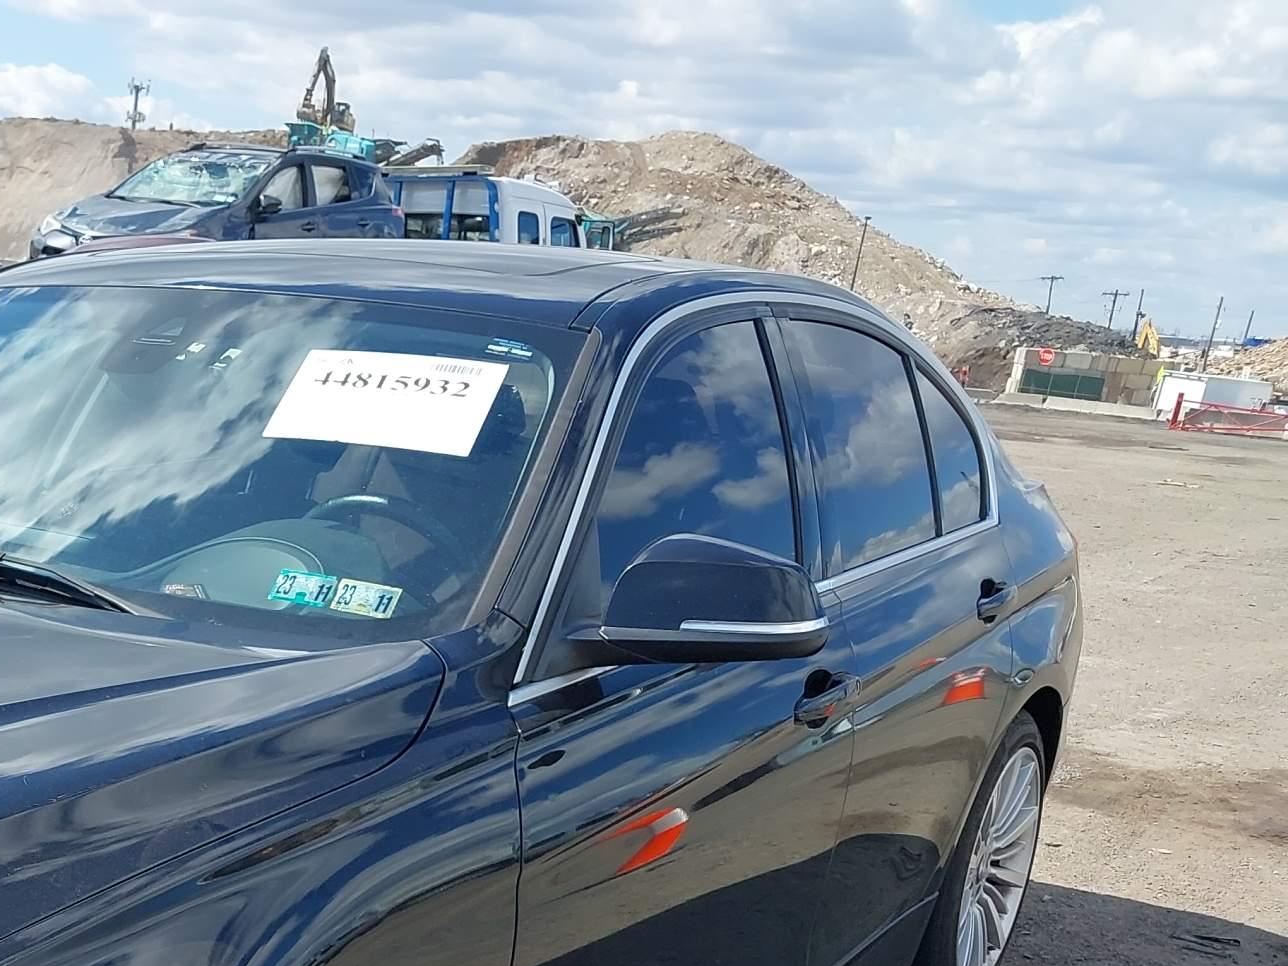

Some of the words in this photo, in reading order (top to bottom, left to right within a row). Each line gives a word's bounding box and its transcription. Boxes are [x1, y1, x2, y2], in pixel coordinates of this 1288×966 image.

[315, 370, 470, 398] 44815932
[276, 574, 297, 595] 23
[337, 583, 357, 606] 23
